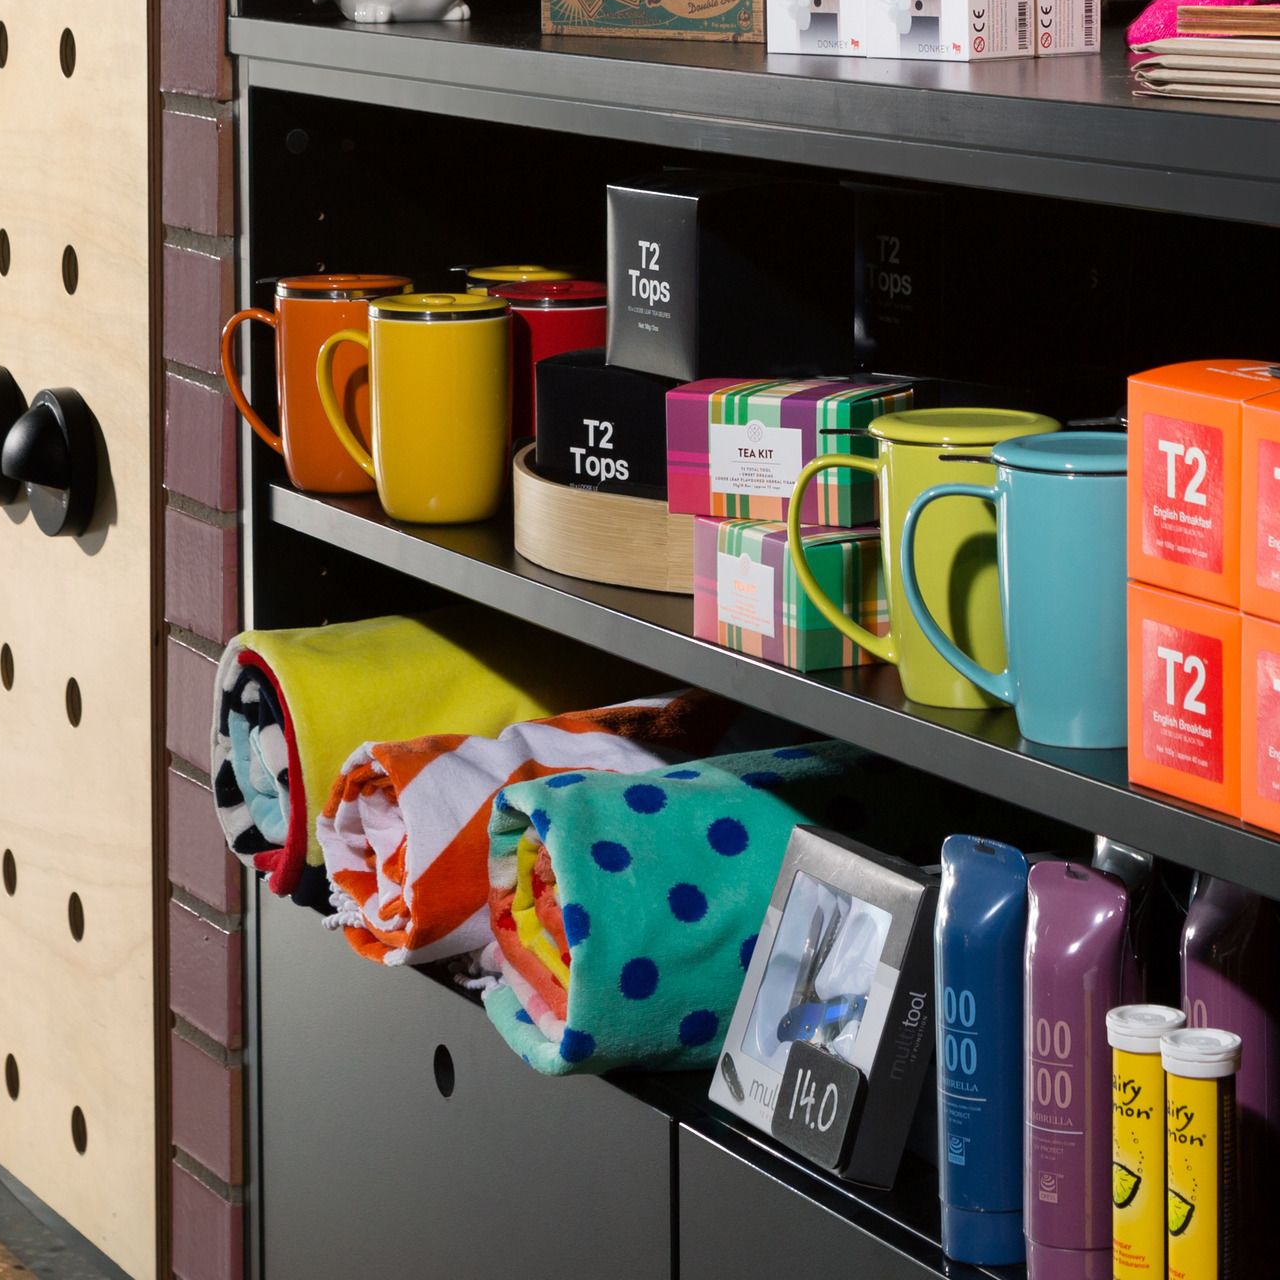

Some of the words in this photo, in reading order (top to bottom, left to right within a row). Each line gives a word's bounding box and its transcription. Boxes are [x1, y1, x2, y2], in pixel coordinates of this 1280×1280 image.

[817, 40, 848, 49] DONKEY
[918, 44, 950, 53] DONKEY
[638, 240, 660, 271] T2
[876, 234, 900, 264] T2
[628, 268, 670, 306] Tops
[864, 262, 912, 299] Tops
[582, 418, 614, 450] T2
[569, 446, 630, 482] Tops
[738, 448, 756, 458] TEA
[758, 448, 774, 459] KIT
[1158, 439, 1207, 506] T2
[1153, 505, 1178, 521] English
[1180, 511, 1212, 528] Breakfast
[1158, 646, 1206, 716] T2
[1152, 710, 1178, 730] English
[1179, 720, 1212, 739] Breakfast
[890, 992, 928, 1080] multitool
[788, 1068, 838, 1132] 14.0
